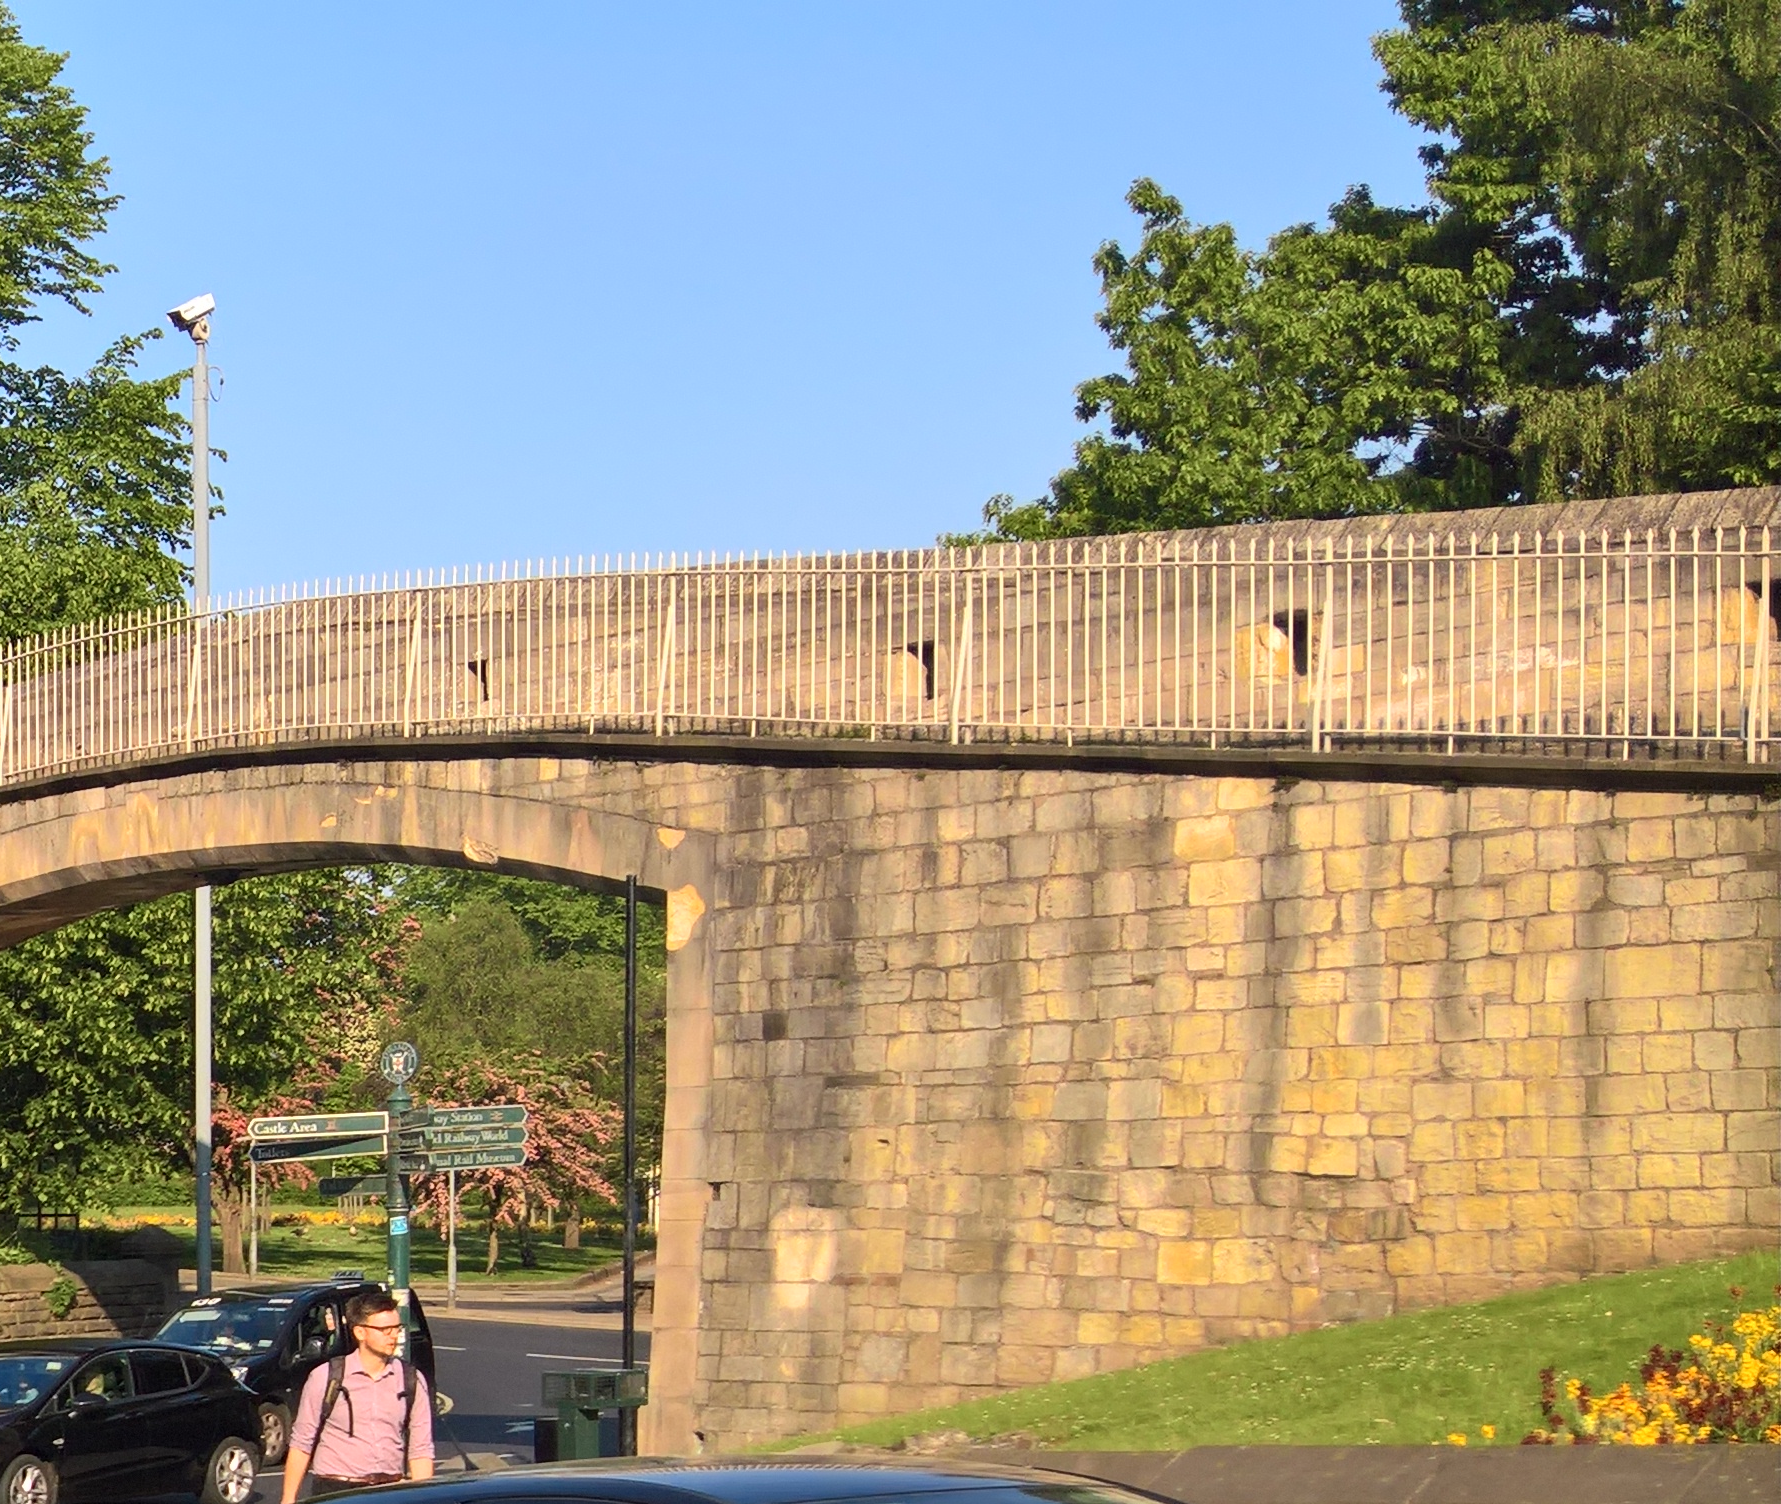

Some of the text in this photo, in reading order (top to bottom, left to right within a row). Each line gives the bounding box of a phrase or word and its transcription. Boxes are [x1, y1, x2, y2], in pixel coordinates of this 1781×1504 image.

[450, 1111, 483, 1123] Station
[254, 1121, 317, 1134] Castle Area
[444, 1132, 481, 1145] Railway
[481, 1130, 508, 1142] World
[454, 1153, 474, 1165] Rail
[476, 1153, 516, 1165] Museum
